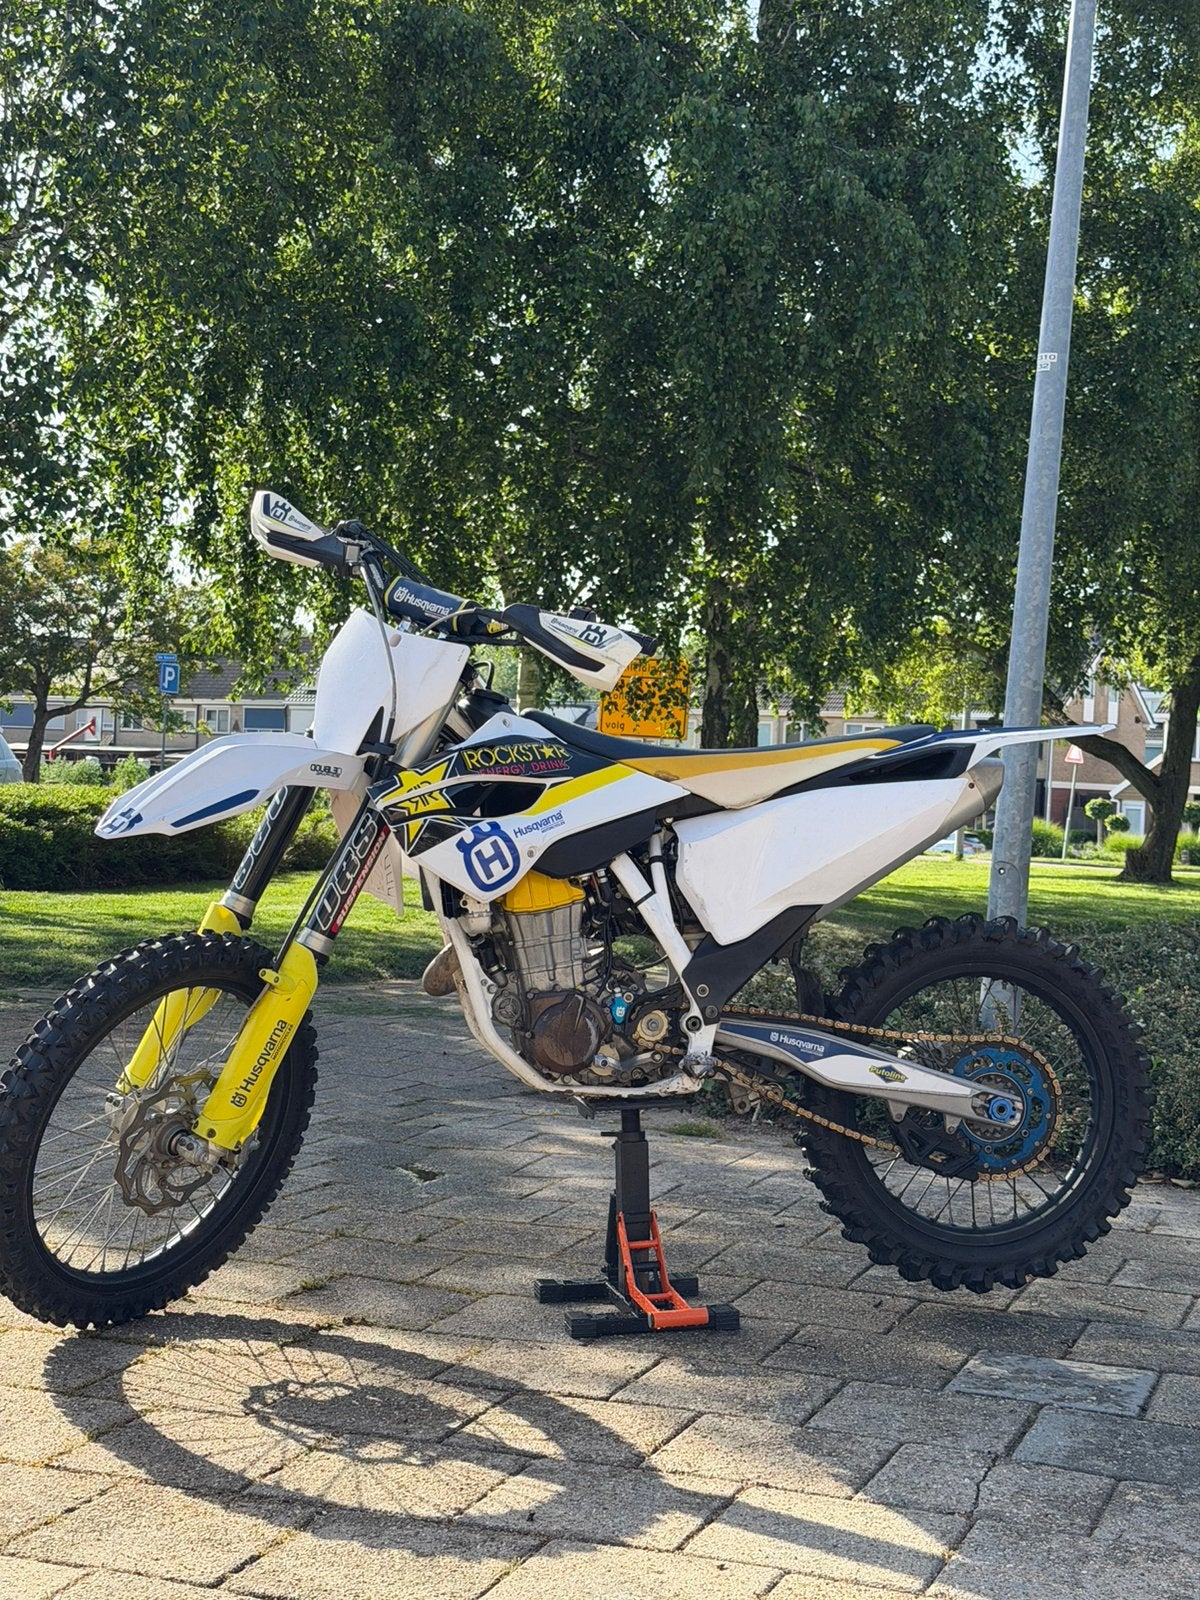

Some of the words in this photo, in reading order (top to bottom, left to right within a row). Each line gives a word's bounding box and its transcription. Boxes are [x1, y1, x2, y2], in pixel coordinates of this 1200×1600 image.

[404, 592, 450, 616] Husqvarna
[164, 667, 176, 689] P
[605, 721, 625, 732] volg
[531, 759, 565, 772] DRINK
[513, 811, 564, 838] Husqvarna
[335, 832, 386, 926] SUSPENSION
[780, 1033, 825, 1053] Husqvarna
[240, 1020, 288, 1093] Husqvarna
[869, 1065, 906, 1081] Putoline
